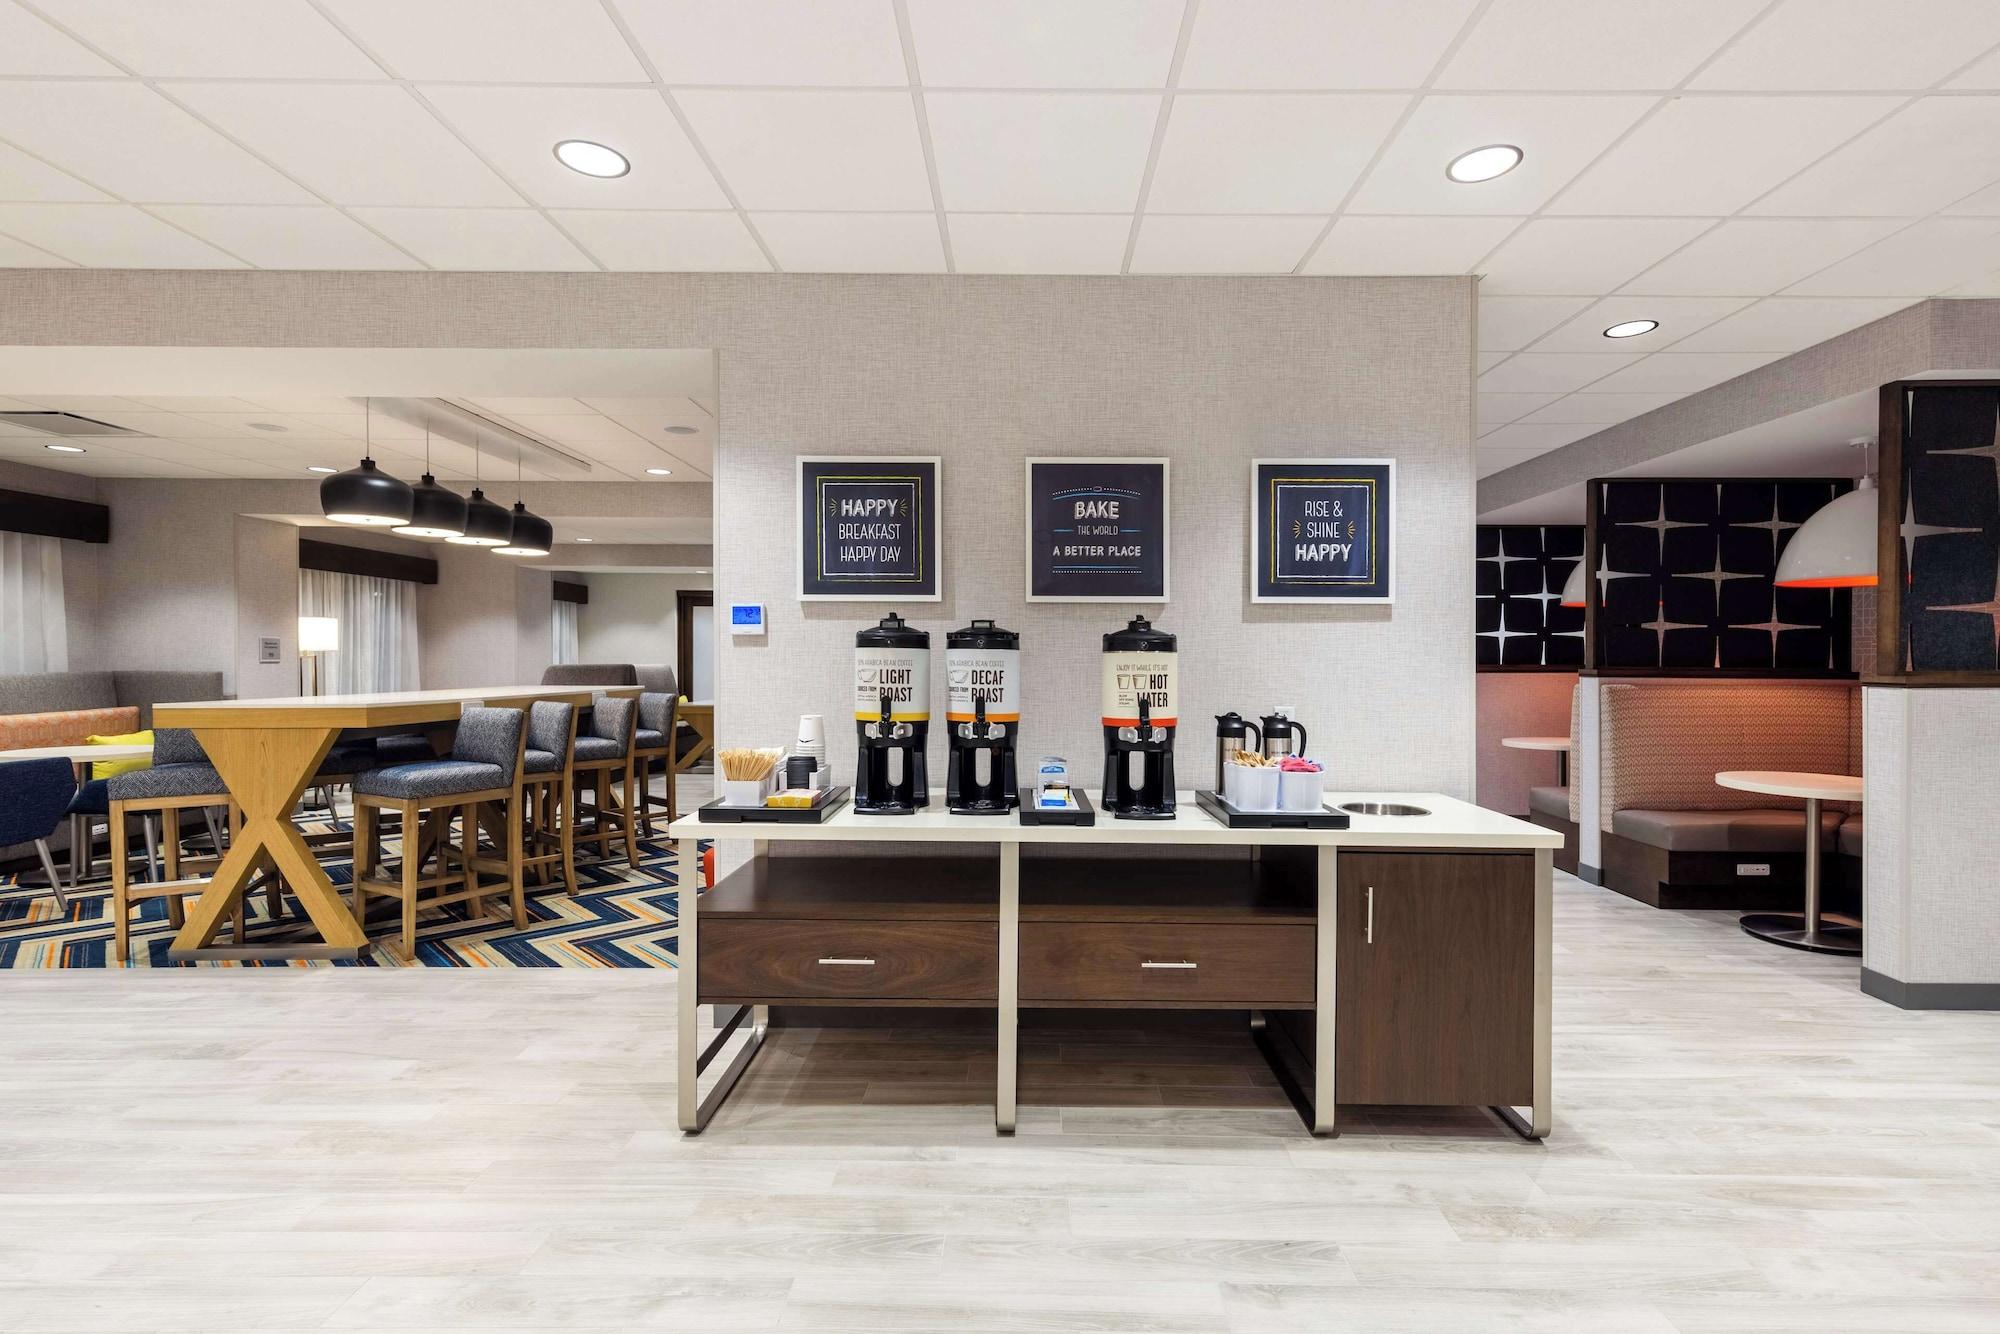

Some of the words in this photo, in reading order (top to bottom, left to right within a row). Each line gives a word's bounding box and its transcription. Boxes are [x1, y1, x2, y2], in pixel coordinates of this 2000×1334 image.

[841, 499, 898, 517] HAPPY
[1074, 500, 1120, 519] BAKE
[1304, 500, 1330, 517] RISE
[1333, 500, 1343, 517] &
[838, 523, 901, 540] BREAKFAST
[1077, 525, 1090, 536] THE
[1093, 525, 1119, 536] WORLD
[1306, 521, 1340, 538] SHINE
[840, 546, 877, 562] HAPPY
[880, 546, 901, 562] DAY
[1052, 545, 1061, 557] A
[1064, 545, 1104, 557] BETTER
[1108, 545, 1142, 557] PLACE
[1295, 543, 1352, 562] HAPPY
[880, 669, 912, 684] LIGHT
[971, 670, 1004, 685] DECAF
[1150, 674, 1168, 689] HOT
[880, 687, 913, 702] ROAST
[971, 687, 1004, 703] ROAST
